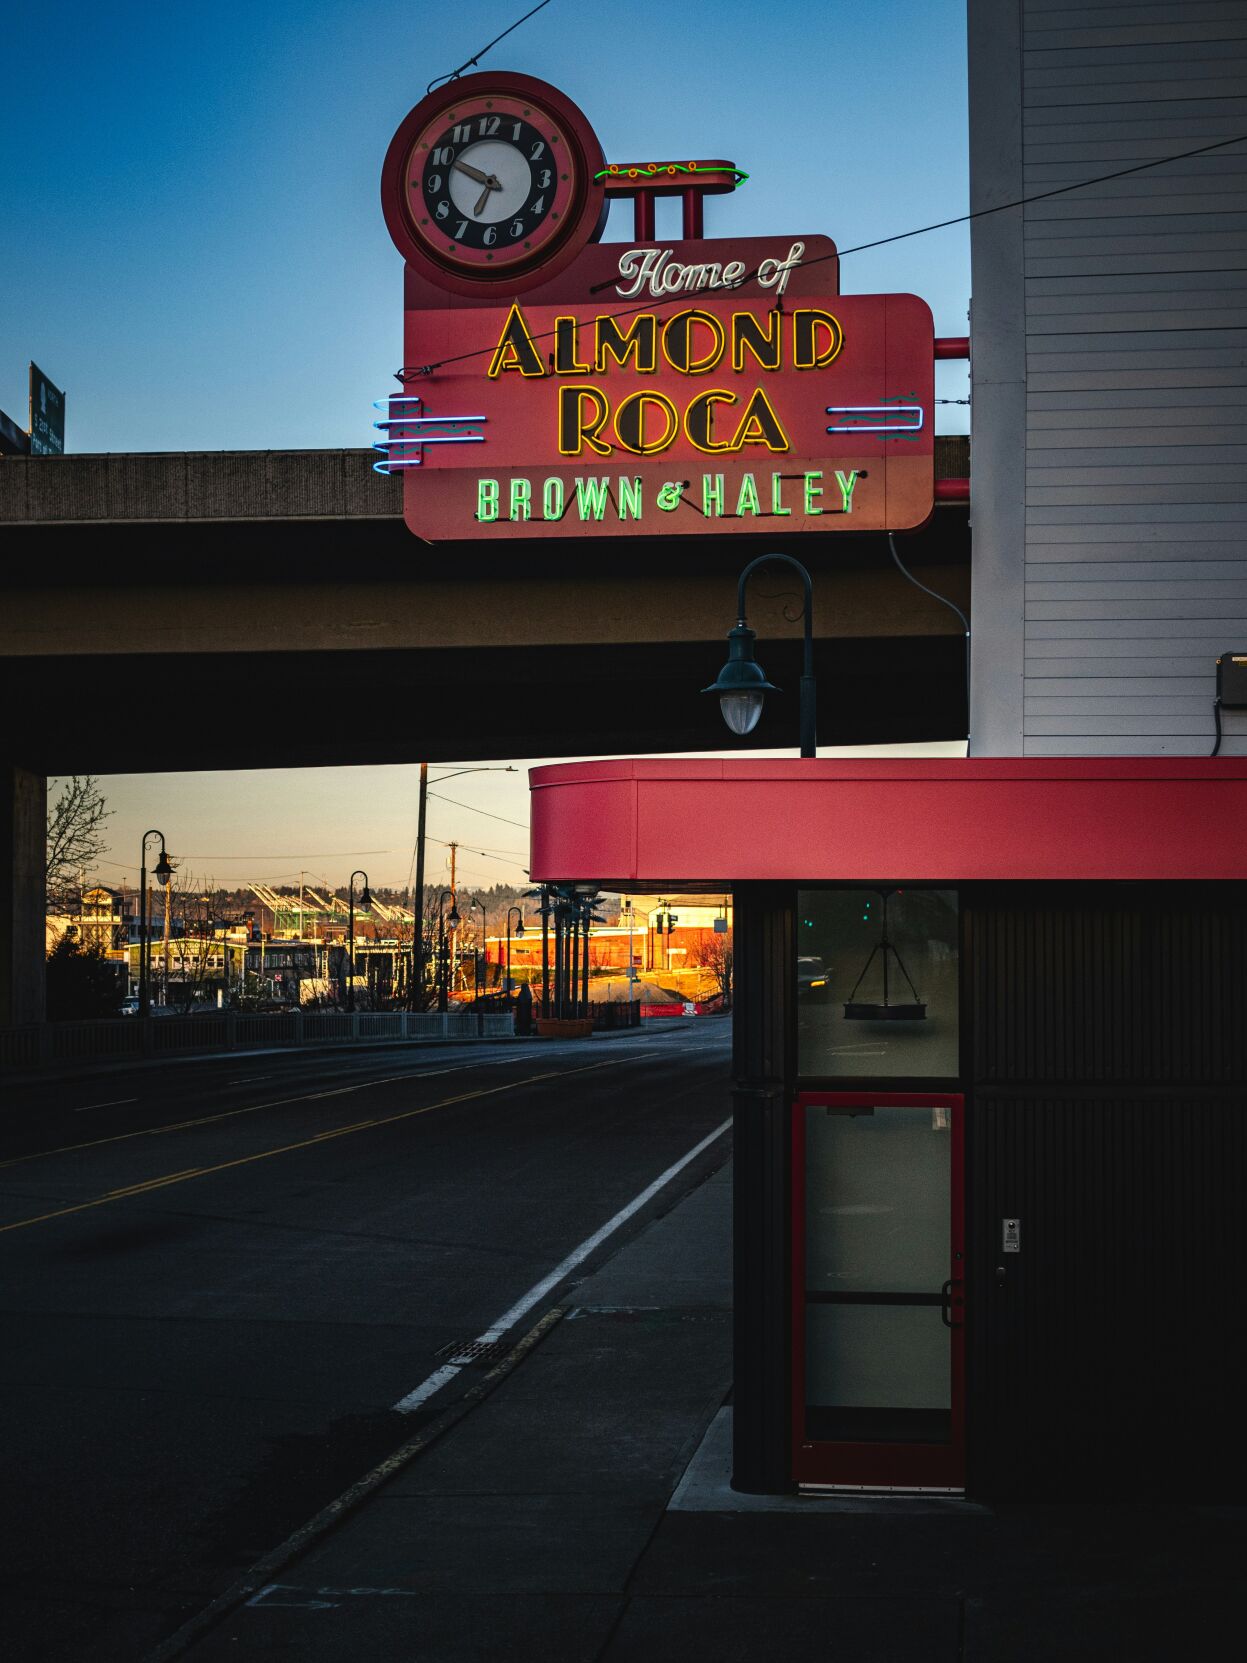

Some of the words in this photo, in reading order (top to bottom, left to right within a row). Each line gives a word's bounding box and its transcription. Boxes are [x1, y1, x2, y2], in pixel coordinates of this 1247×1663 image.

[452, 124, 472, 143] 11
[478, 116, 501, 136] 12
[512, 122, 522, 141] 1
[432, 147, 455, 166] 10
[530, 141, 545, 161] 2
[428, 174, 442, 194] 9
[537, 169, 551, 189] 3
[435, 200, 450, 220] 8
[530, 195, 544, 214] 4
[454, 220, 470, 239] 7
[483, 226, 497, 246] 6
[509, 218, 524, 237] 5
[615, 248, 746, 298] Home
[757, 241, 806, 295] of
[487, 299, 846, 380] ALMOND
[557, 384, 796, 456] ROCA
[476, 476, 643, 522] BROWN
[656, 482, 684, 511] &
[703, 470, 859, 518] HALEY
